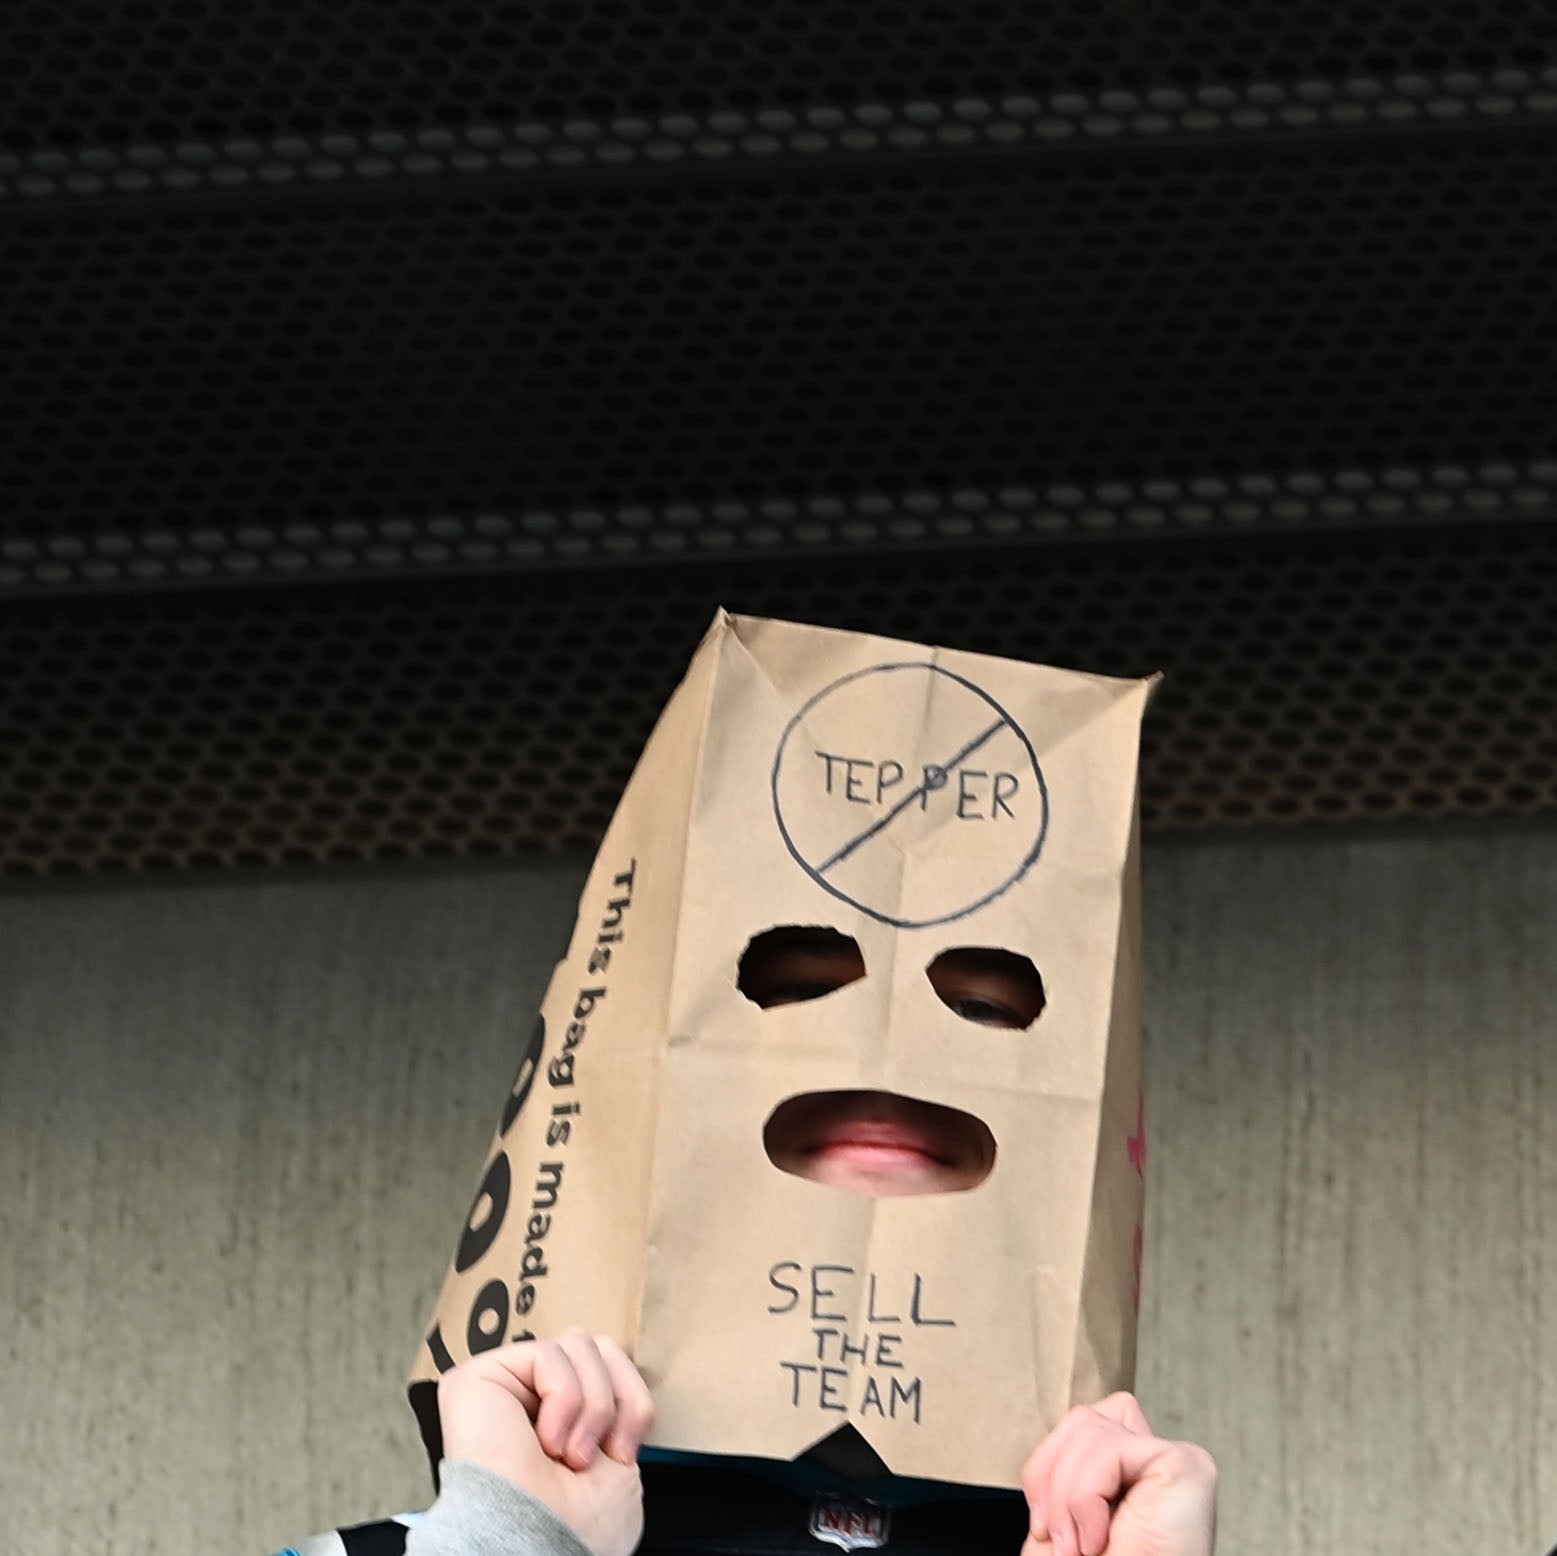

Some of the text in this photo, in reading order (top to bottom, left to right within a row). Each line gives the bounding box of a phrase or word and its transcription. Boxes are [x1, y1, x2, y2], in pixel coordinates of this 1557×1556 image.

[815, 750, 1020, 820] TEPPER
[586, 856, 637, 976] This
[547, 985, 607, 1087] bag
[545, 1101, 581, 1148] is
[514, 1159, 565, 1316] made
[767, 1260, 957, 1328] SELL
[812, 1327, 905, 1369] THE
[779, 1360, 922, 1425] TEAM
